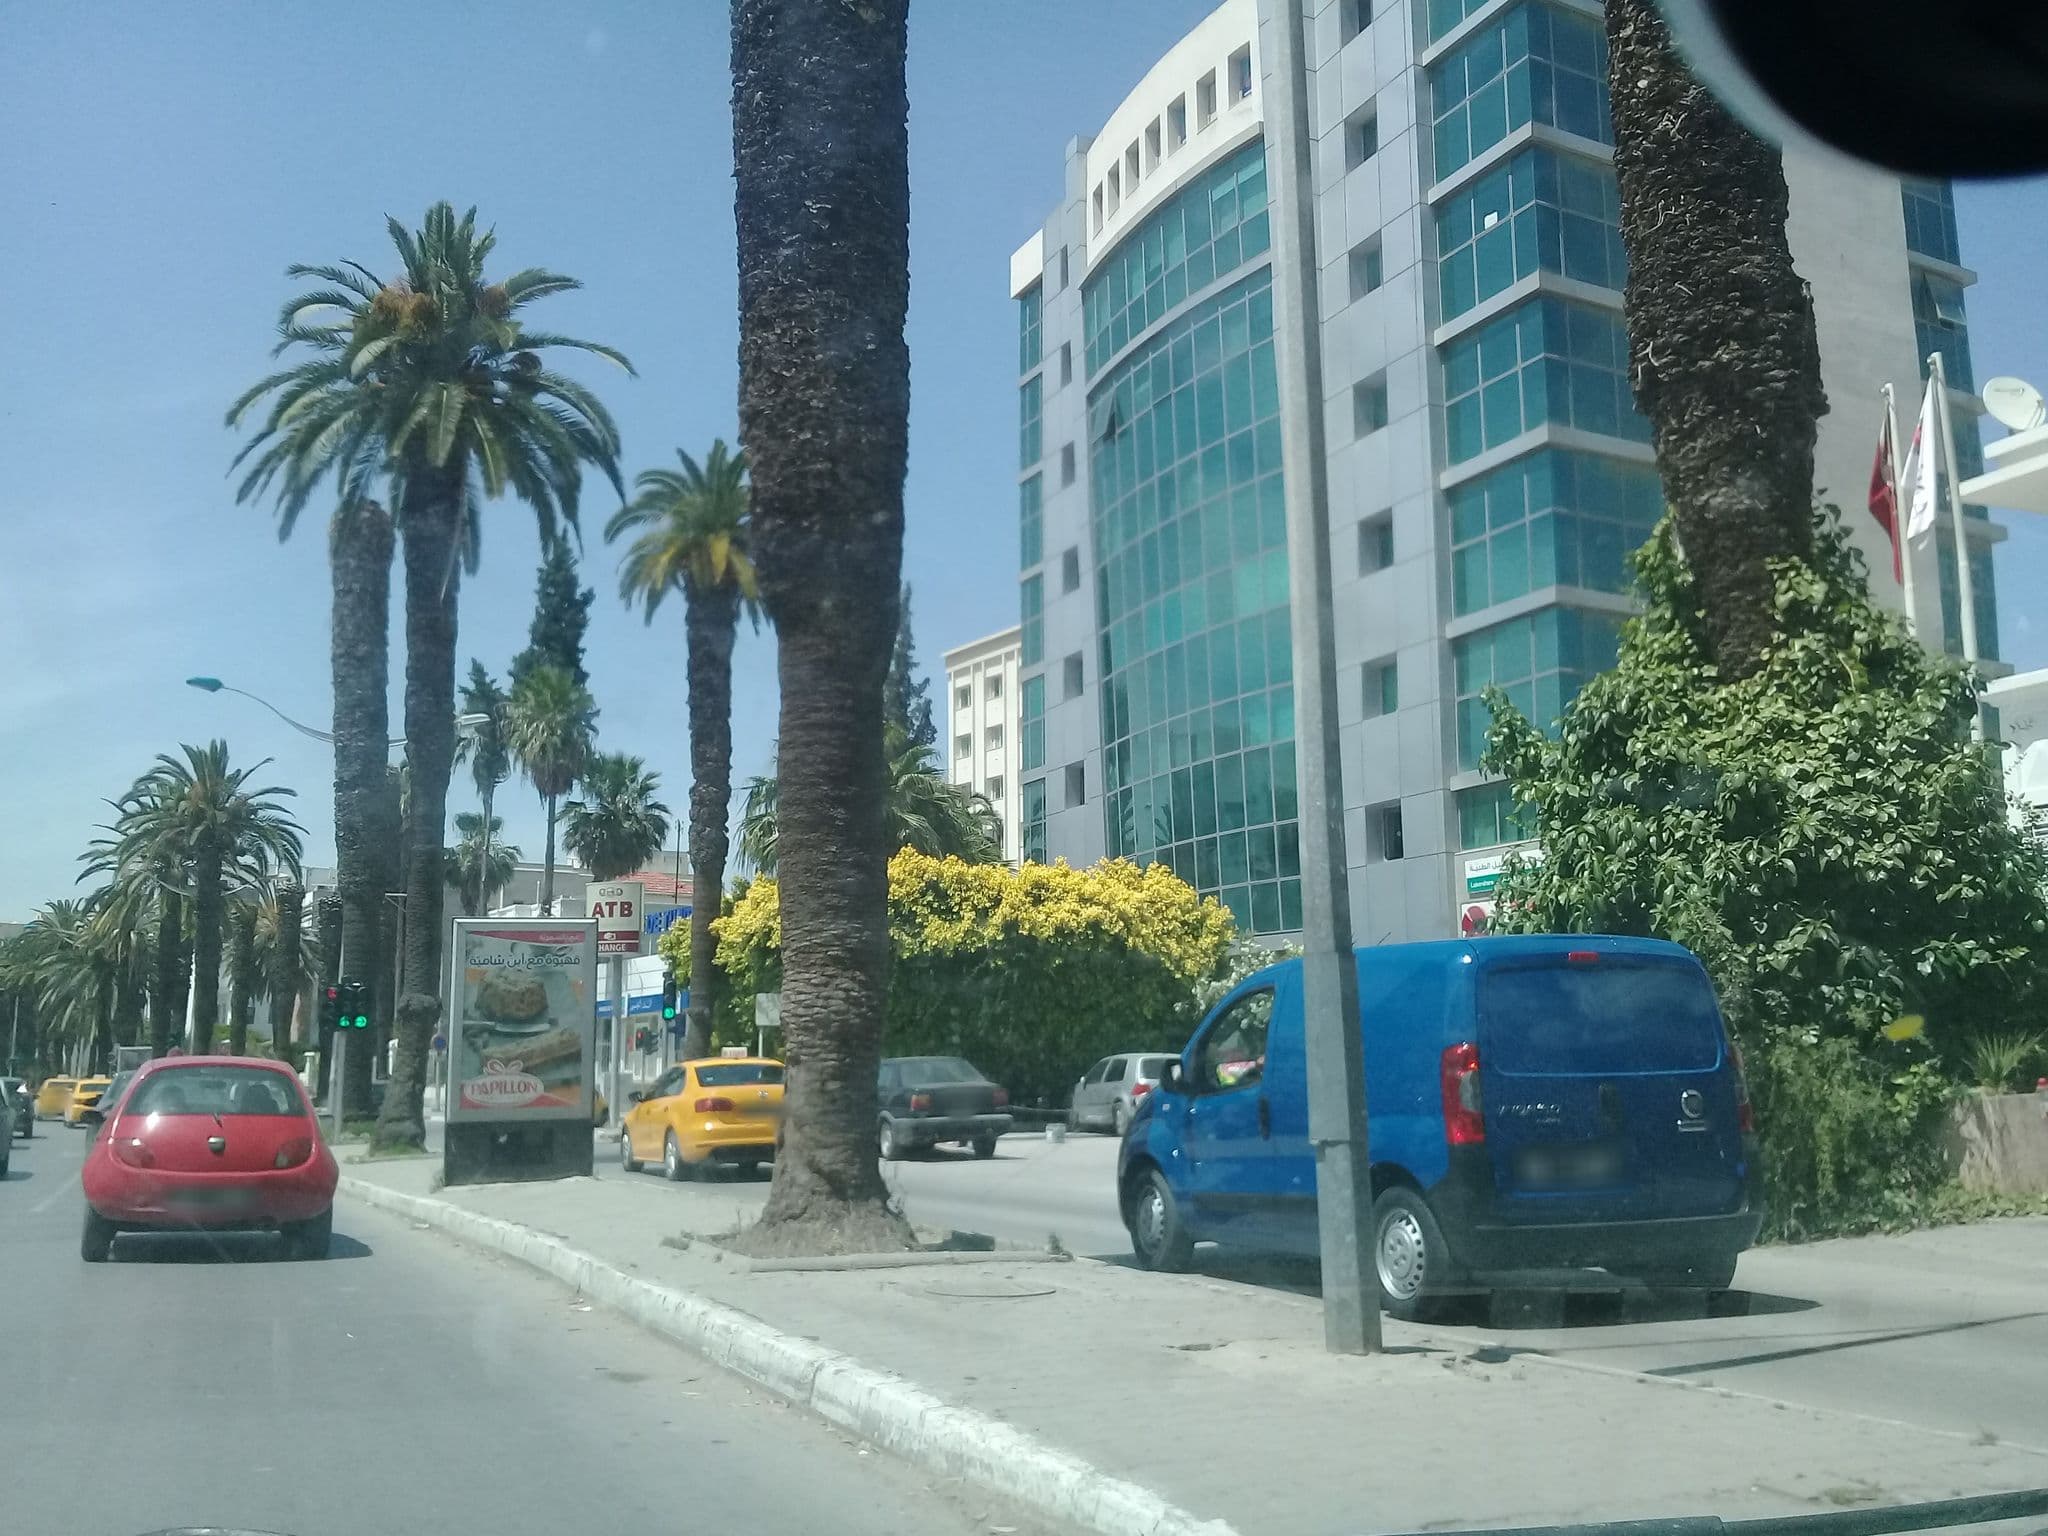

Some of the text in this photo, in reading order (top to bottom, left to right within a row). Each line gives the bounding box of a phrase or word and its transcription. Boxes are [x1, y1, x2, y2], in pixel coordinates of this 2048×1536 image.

[592, 901, 633, 918] ATB
[599, 943, 627, 952] HANGE
[471, 1080, 538, 1095] PAPILLON
